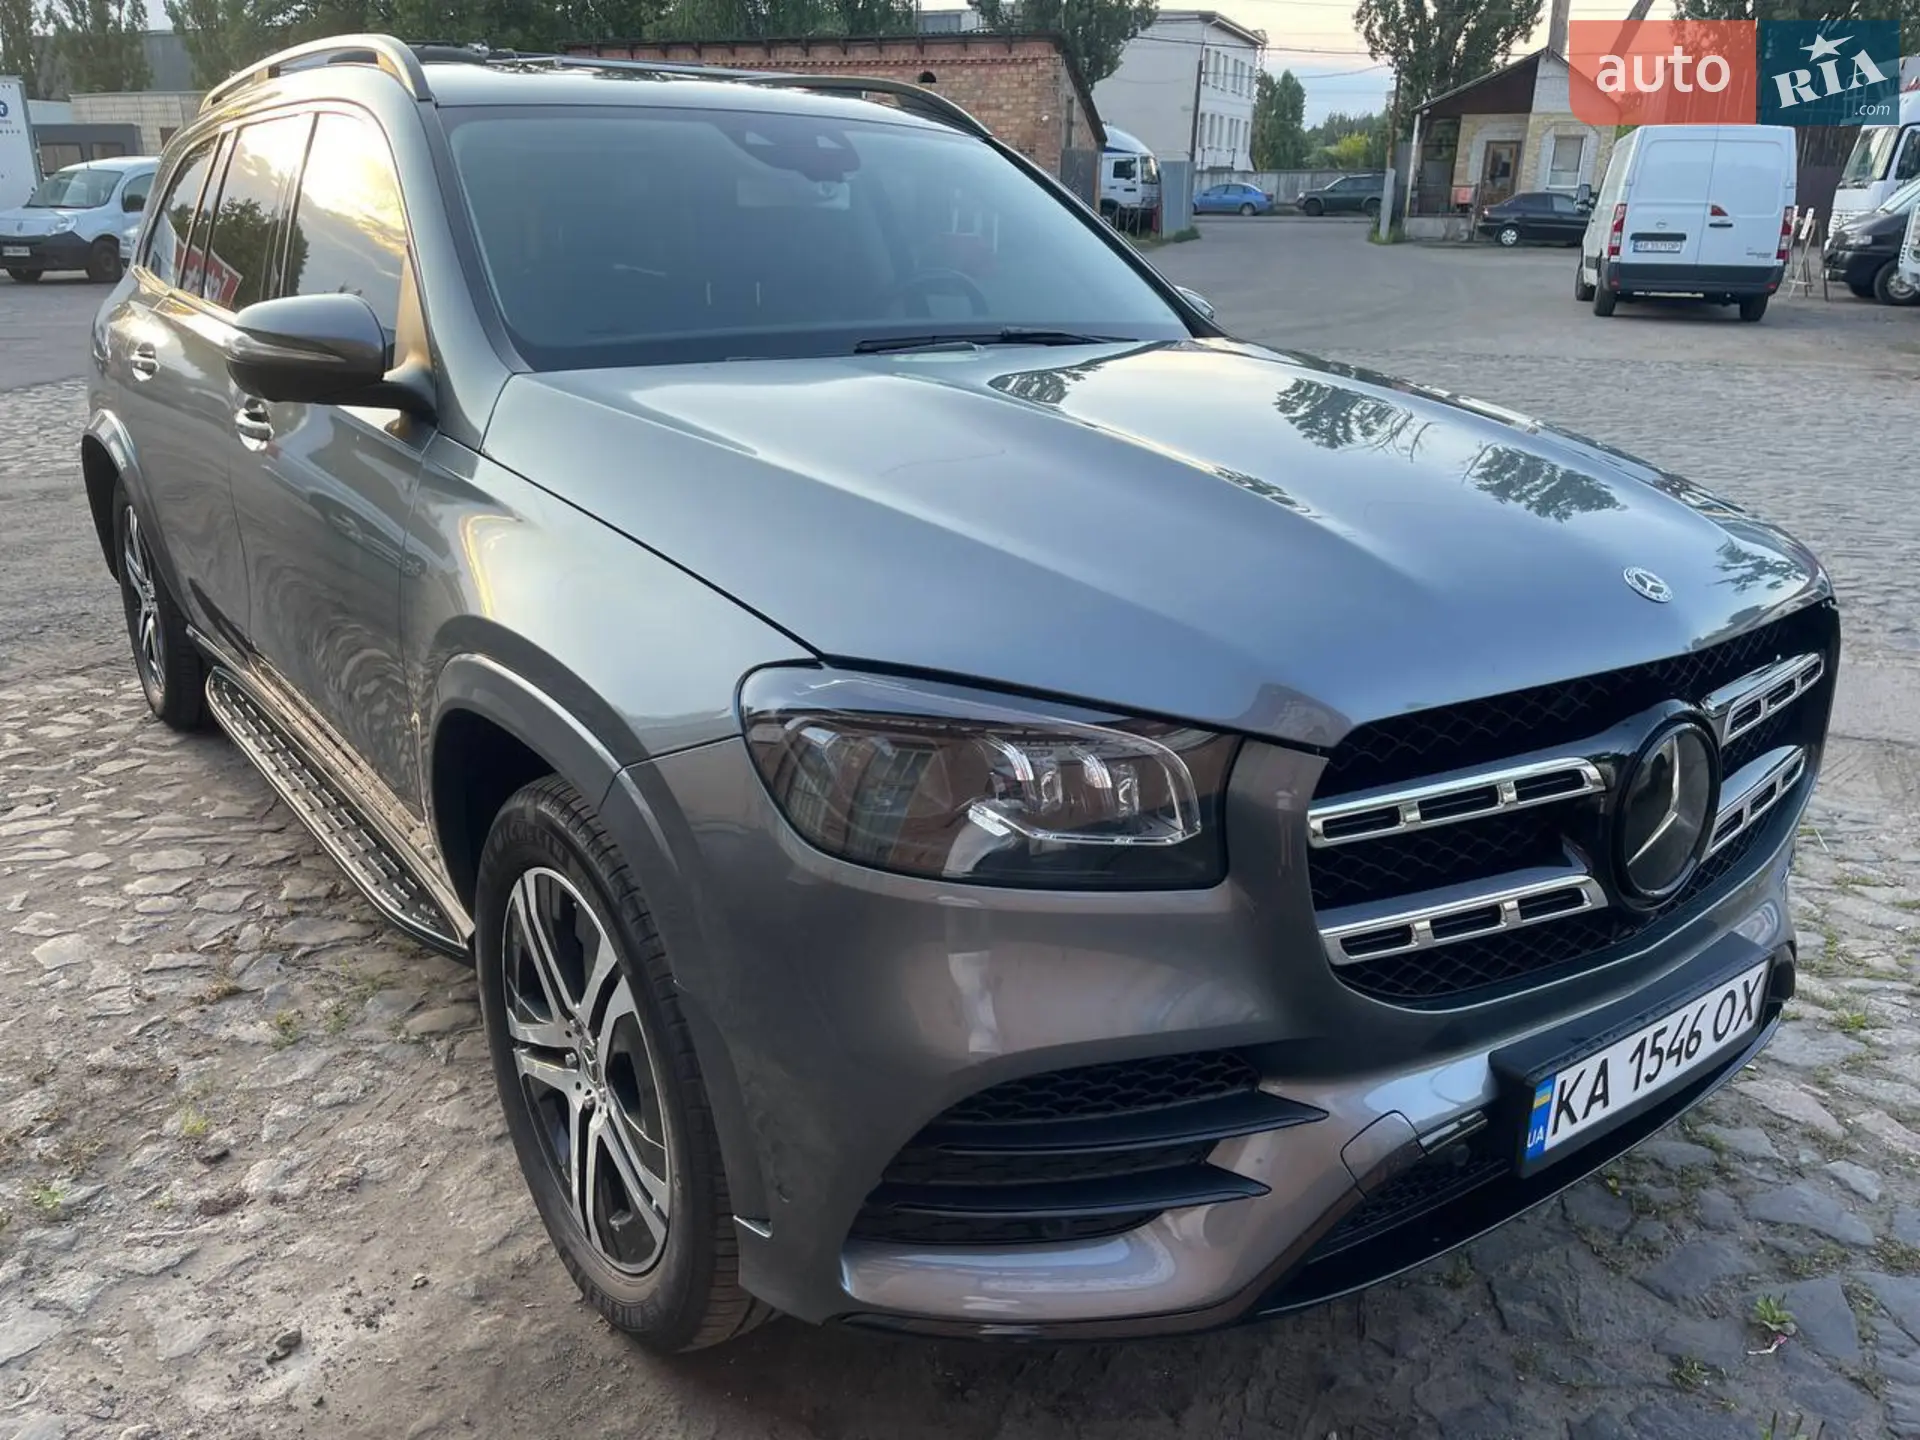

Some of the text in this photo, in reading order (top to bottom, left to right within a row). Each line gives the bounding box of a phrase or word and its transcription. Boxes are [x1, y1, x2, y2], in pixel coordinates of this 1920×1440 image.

[1551, 971, 1764, 1137] KA 1546 OX
[1527, 1131, 1545, 1149] UA
